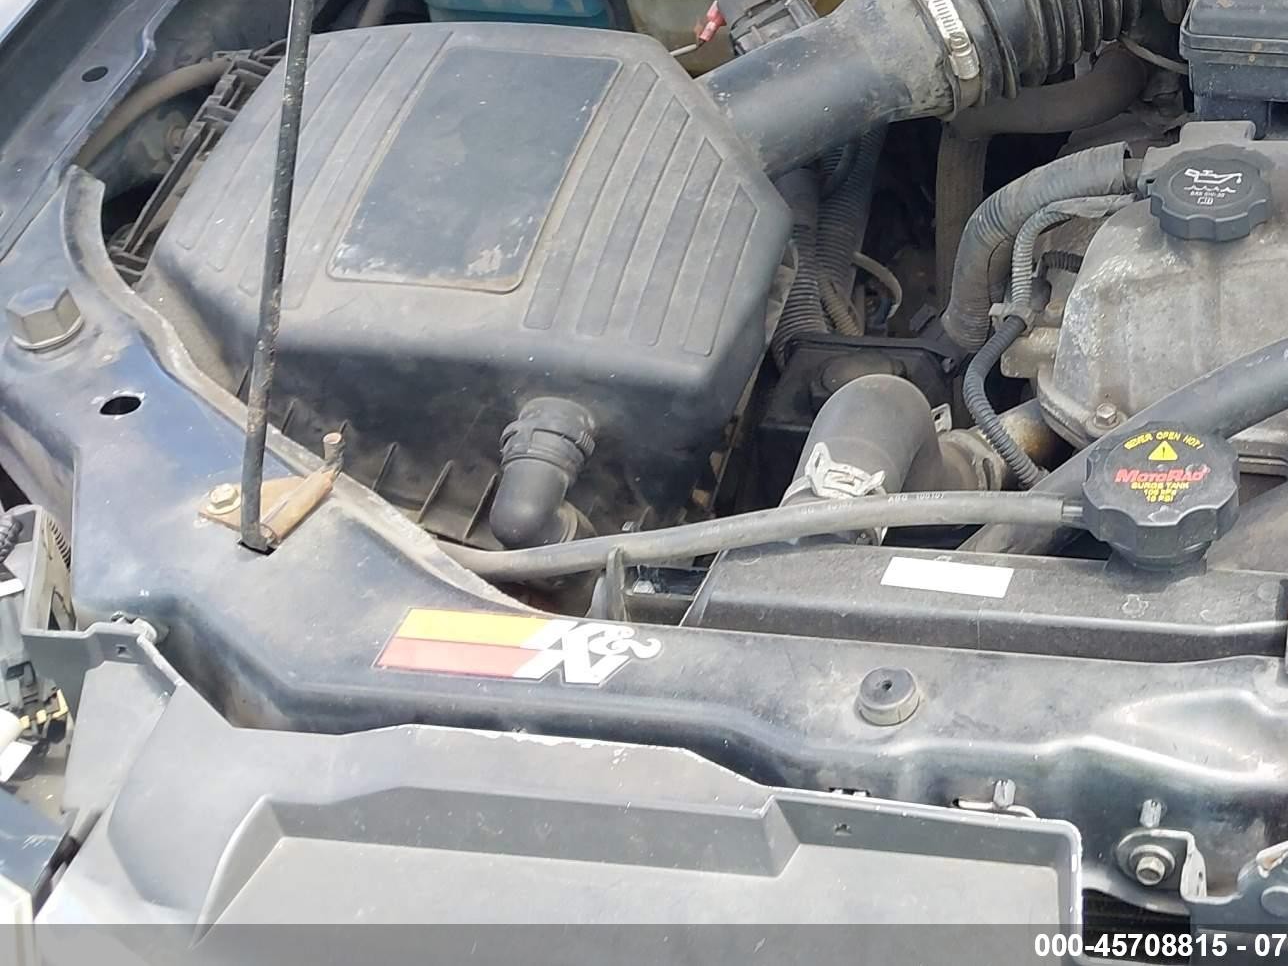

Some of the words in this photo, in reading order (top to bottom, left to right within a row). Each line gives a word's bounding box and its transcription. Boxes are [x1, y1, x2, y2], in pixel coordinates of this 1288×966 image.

[1124, 433, 1153, 450] NEVER
[1156, 431, 1181, 441] OPEN
[1166, 482, 1189, 490] TANK
